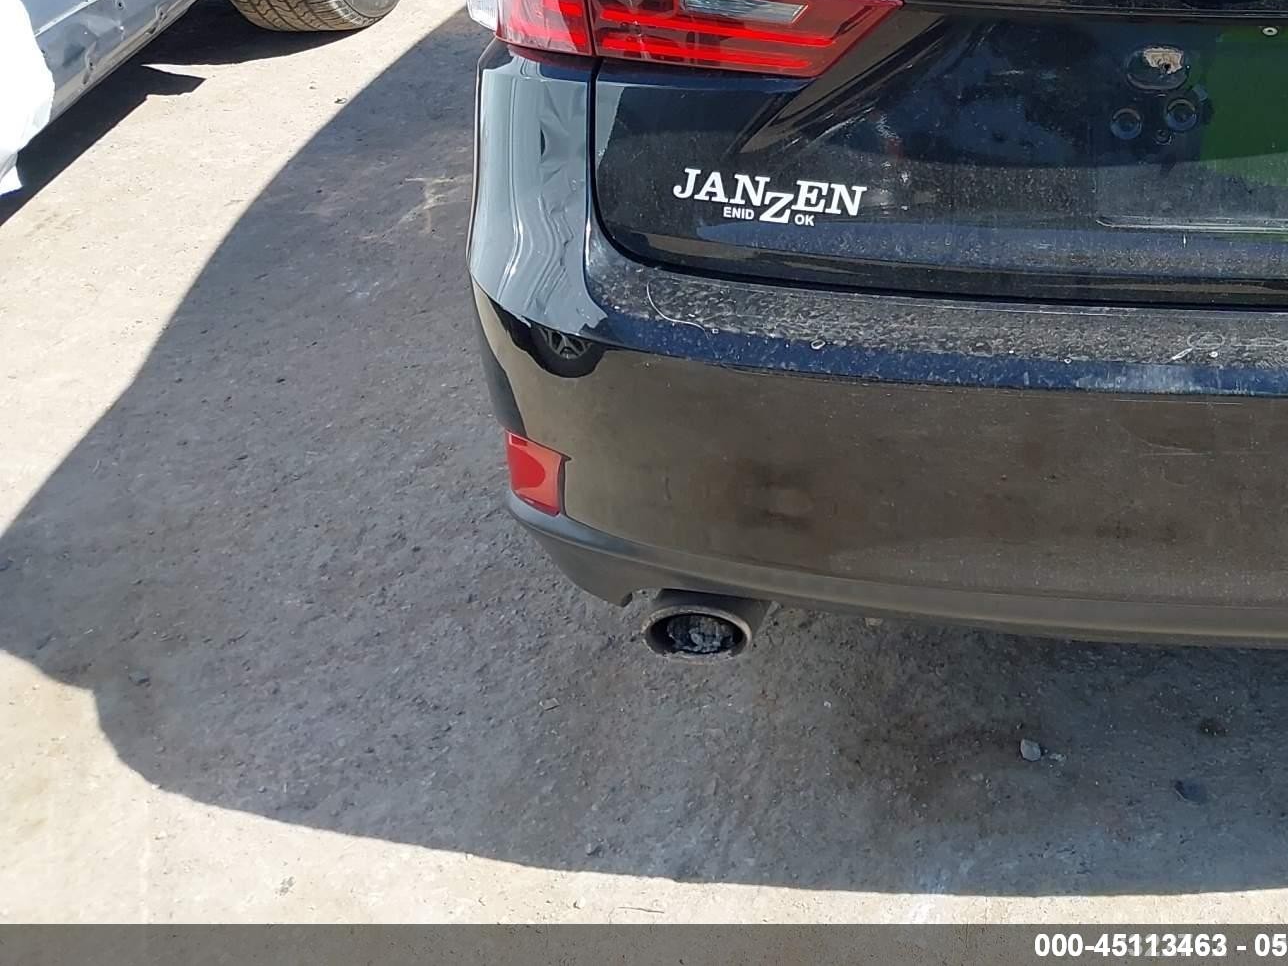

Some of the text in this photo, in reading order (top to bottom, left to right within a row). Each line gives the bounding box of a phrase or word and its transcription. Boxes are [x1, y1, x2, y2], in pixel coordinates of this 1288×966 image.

[672, 167, 868, 224] JANZEN
[722, 206, 816, 227] ENID OK
